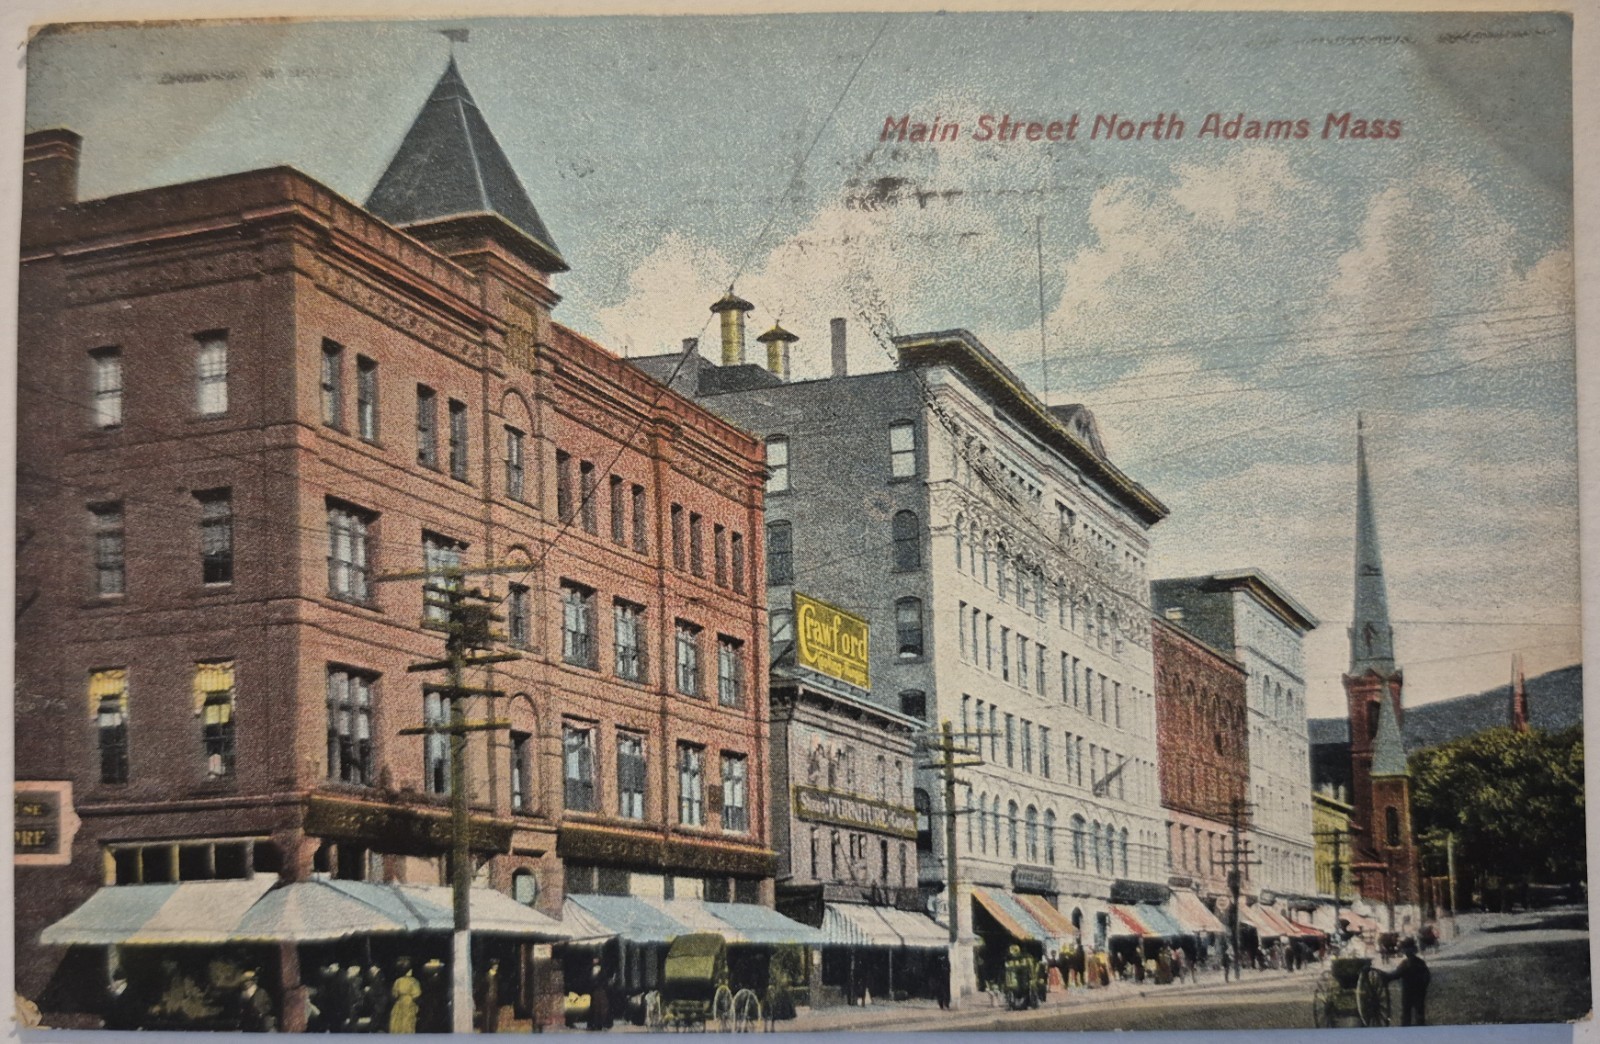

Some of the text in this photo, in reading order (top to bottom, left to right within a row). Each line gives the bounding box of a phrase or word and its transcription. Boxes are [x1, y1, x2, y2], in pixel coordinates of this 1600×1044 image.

[878, 112, 1403, 142] Main Street North Adams Mass
[798, 603, 868, 664] Crawford
